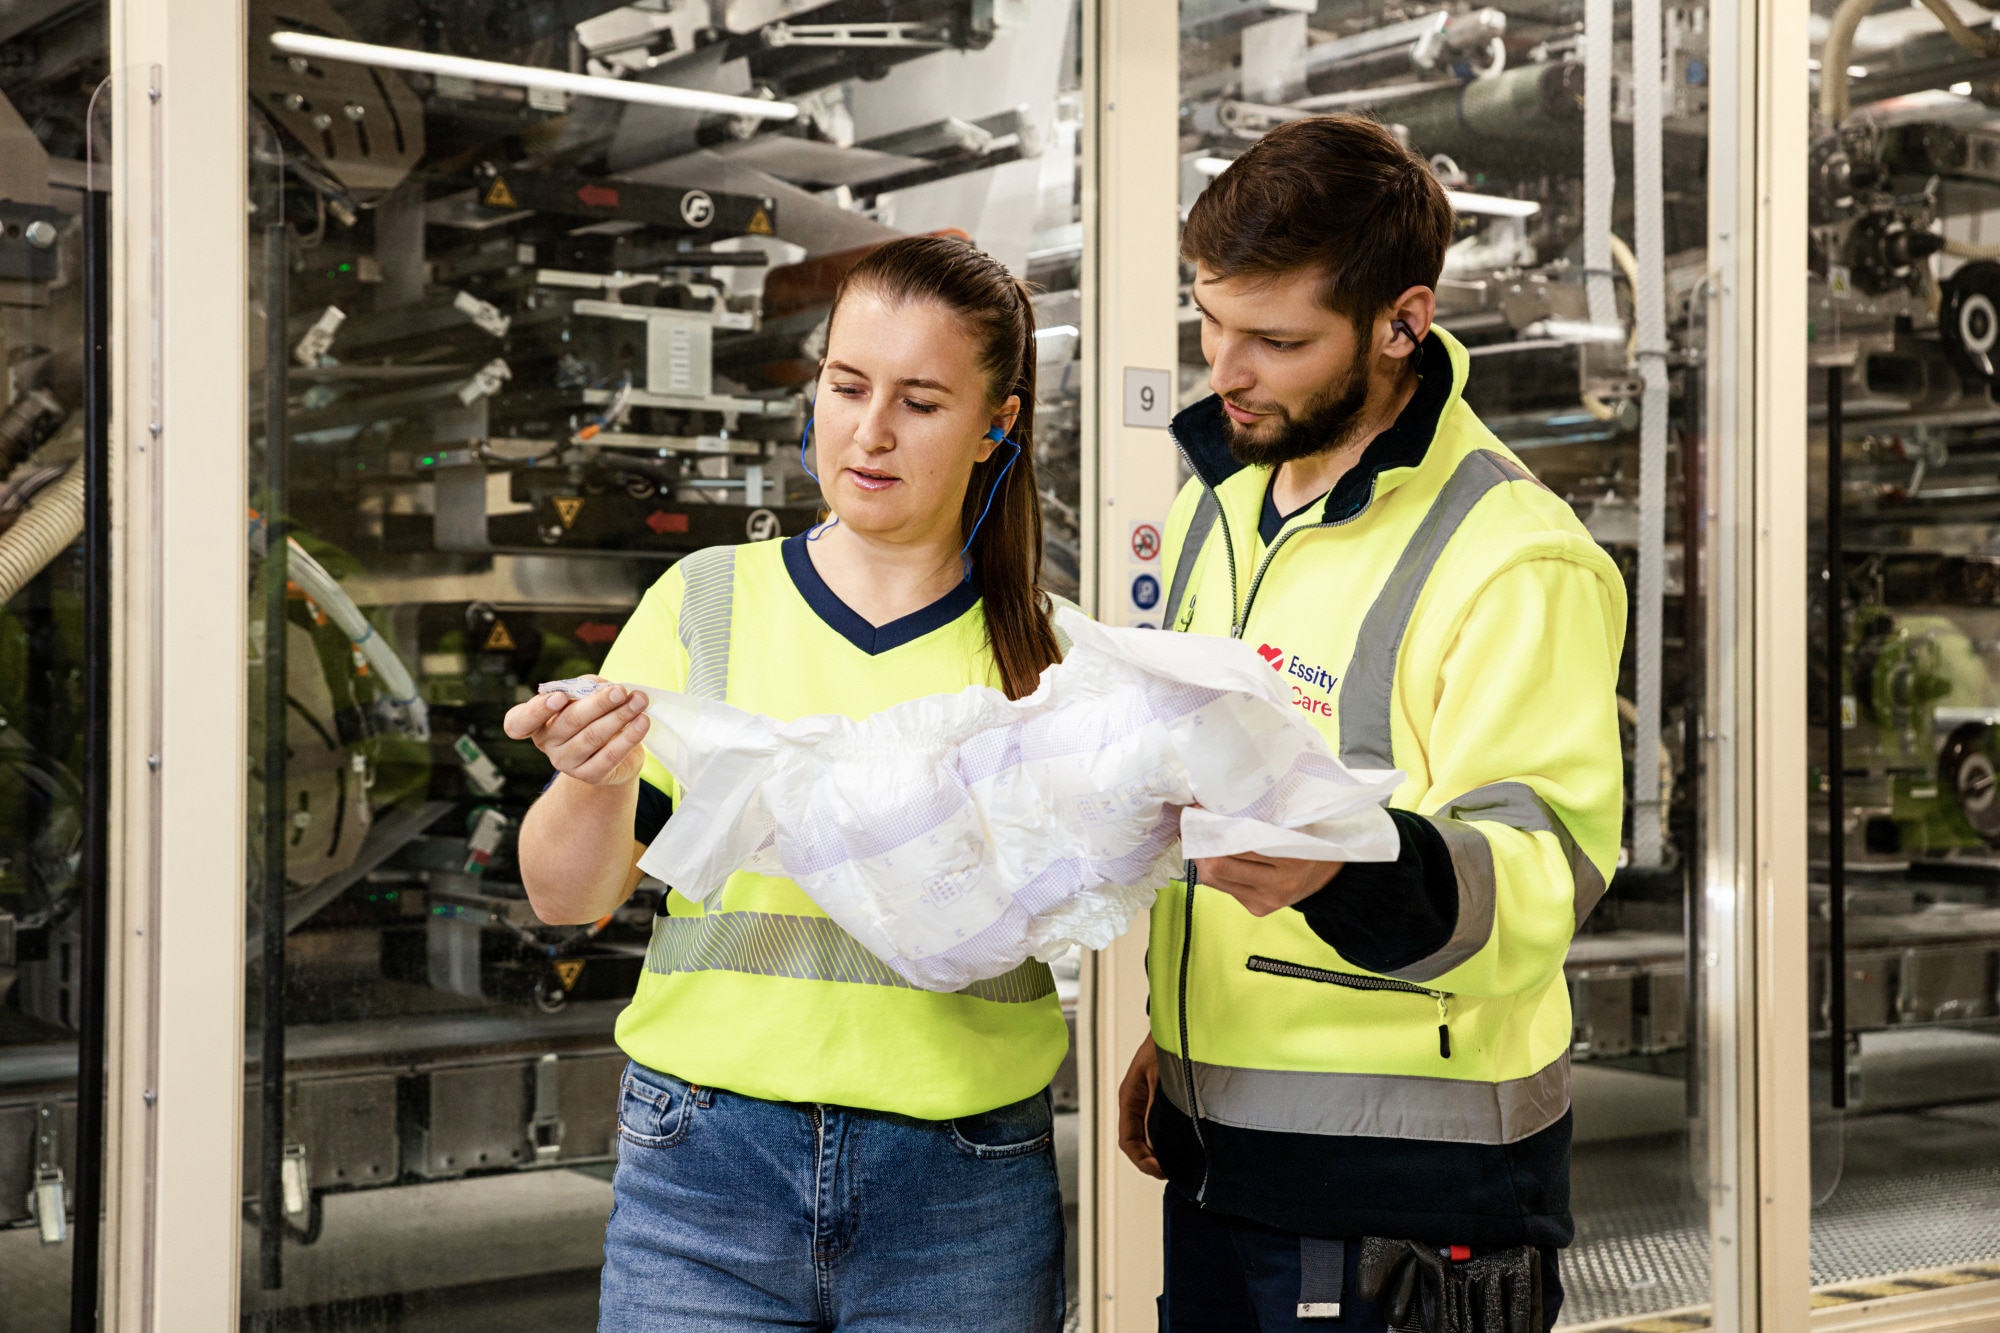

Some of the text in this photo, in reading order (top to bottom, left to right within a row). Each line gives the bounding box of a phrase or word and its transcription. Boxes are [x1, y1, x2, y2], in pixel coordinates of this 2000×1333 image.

[1140, 386, 1155, 411] 9
[1288, 655, 1338, 694] Essity
[1100, 800, 1117, 815] M
[928, 834, 940, 847] M
[881, 857, 893, 868] M
[826, 872, 837, 883] M
[953, 928, 965, 939] M
